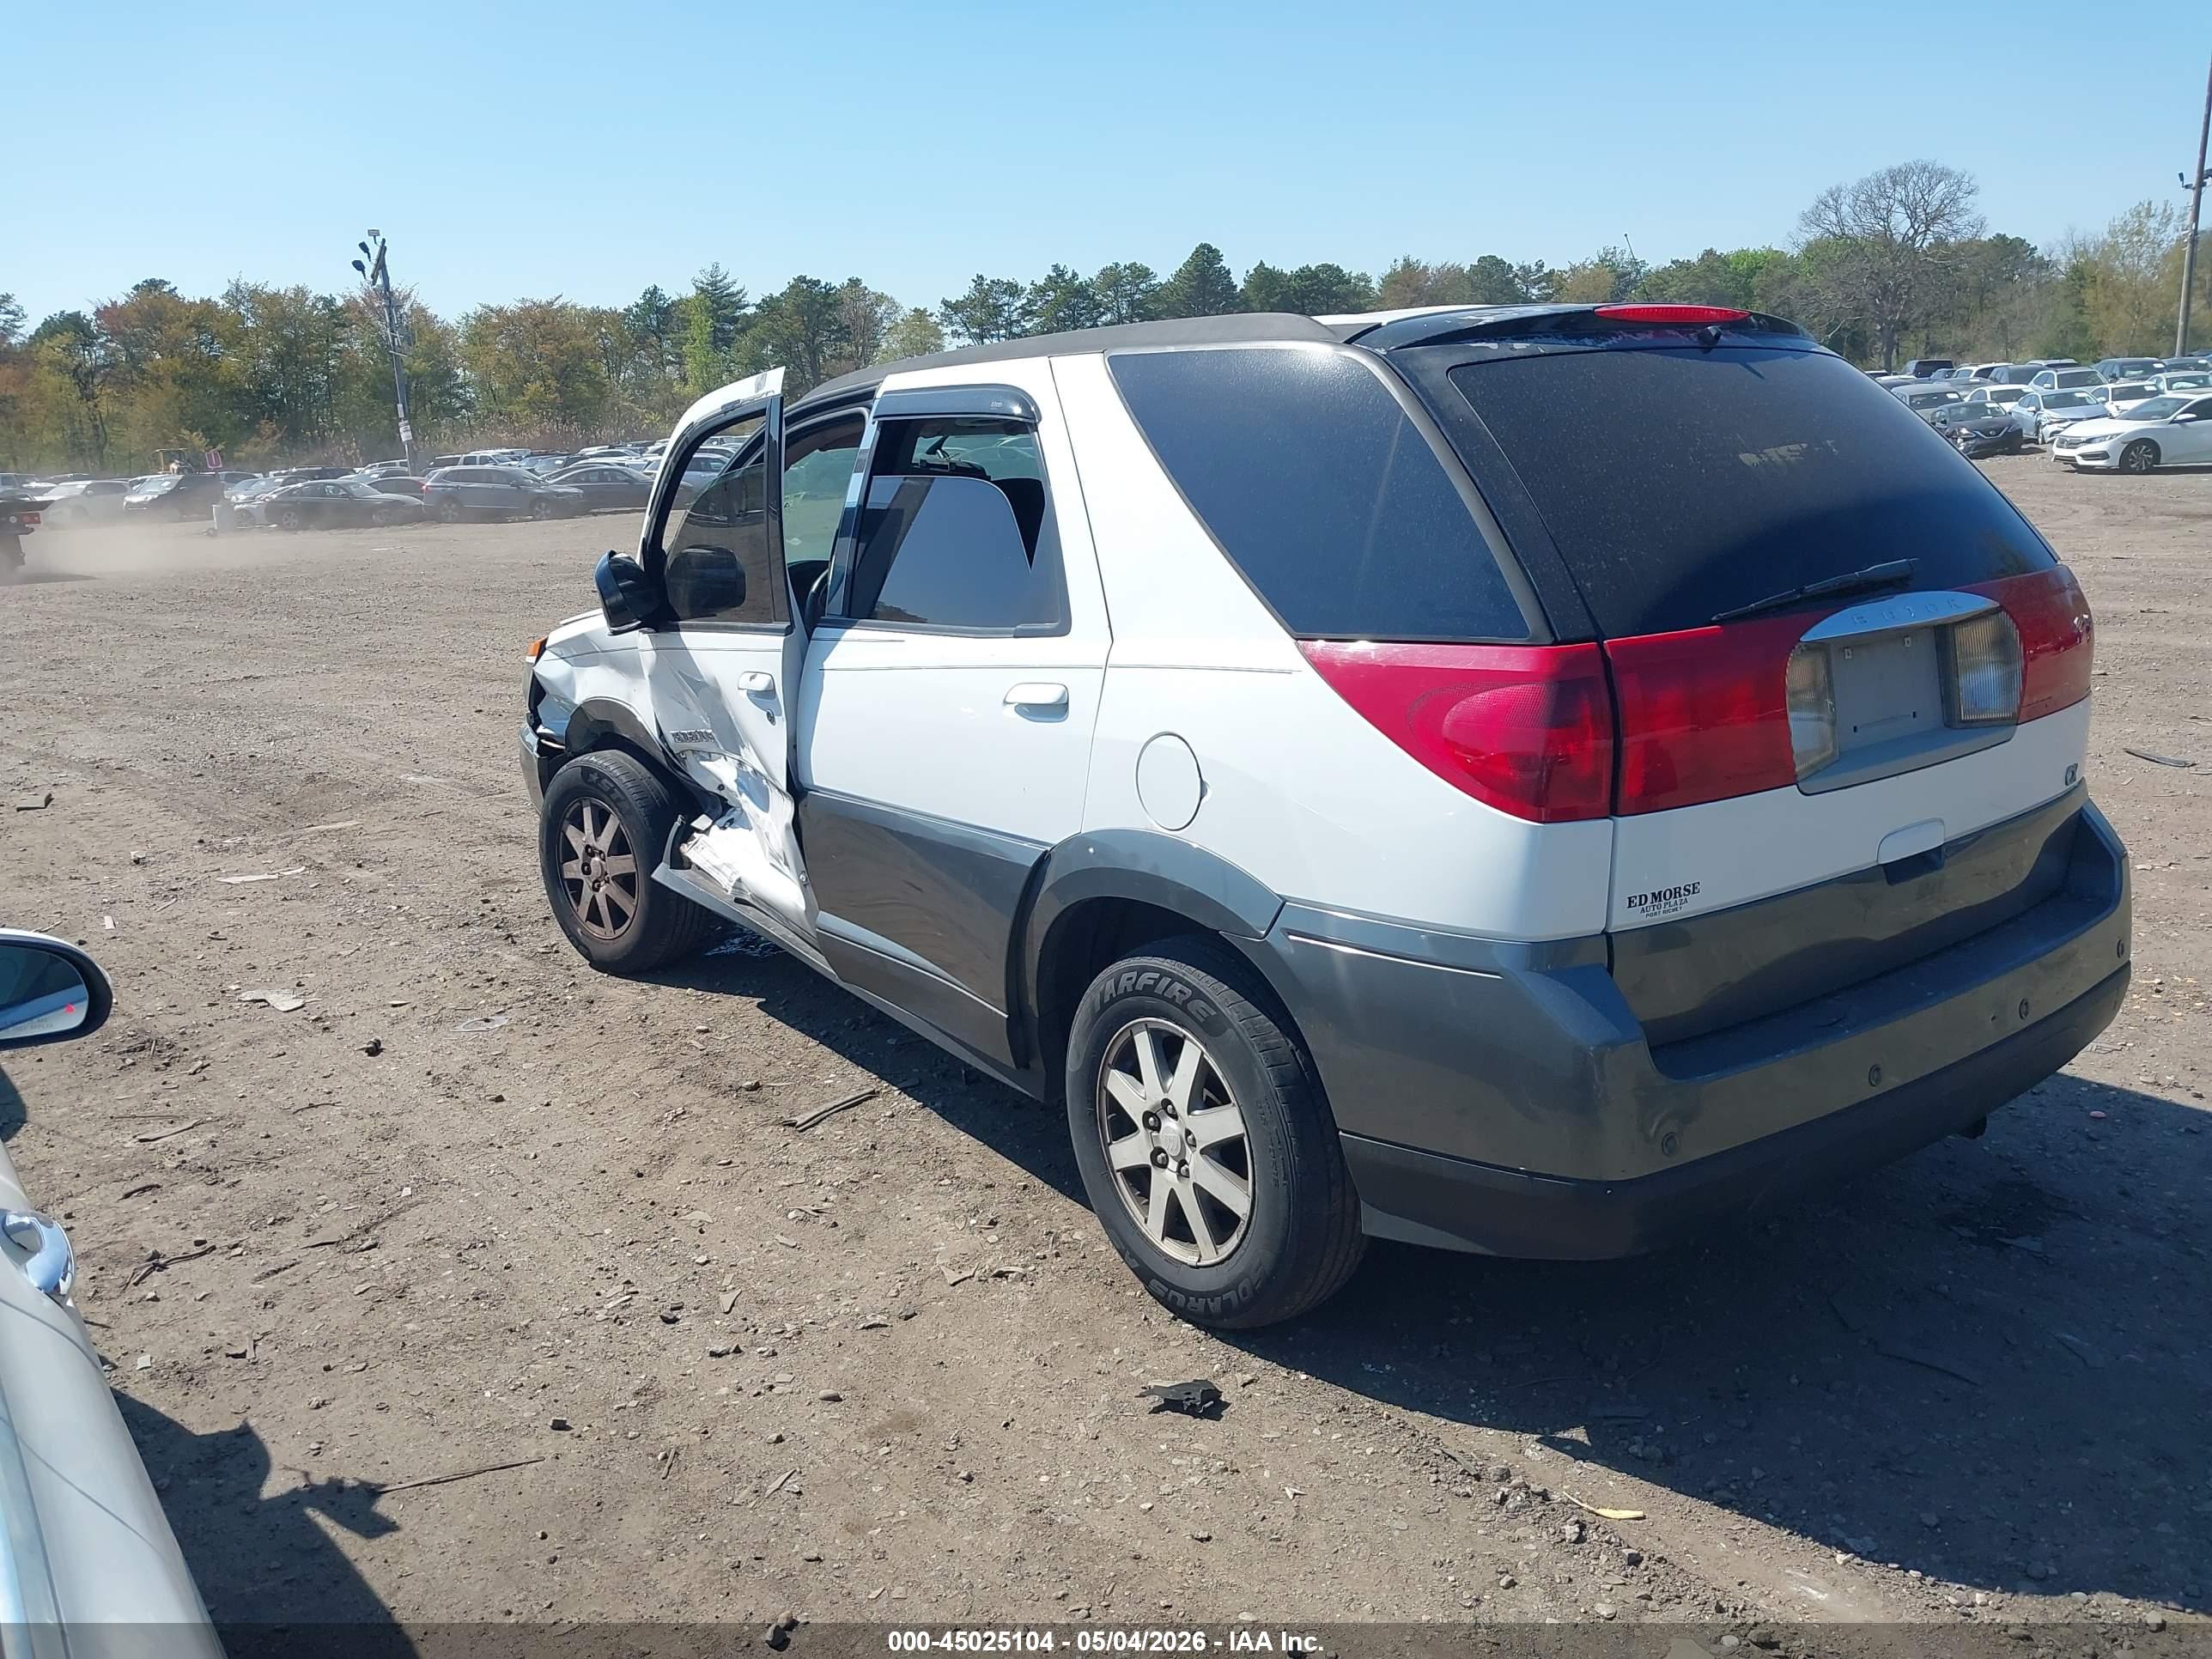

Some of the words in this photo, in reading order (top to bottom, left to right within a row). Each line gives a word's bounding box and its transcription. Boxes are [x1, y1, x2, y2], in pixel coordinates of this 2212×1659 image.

[1627, 893, 1648, 908] ED
[1650, 881, 1700, 904] MORSE
[1639, 902, 1662, 914] AUTO
[1662, 897, 1688, 909] PLAZA
[1082, 970, 1217, 1024] TARFIRE
